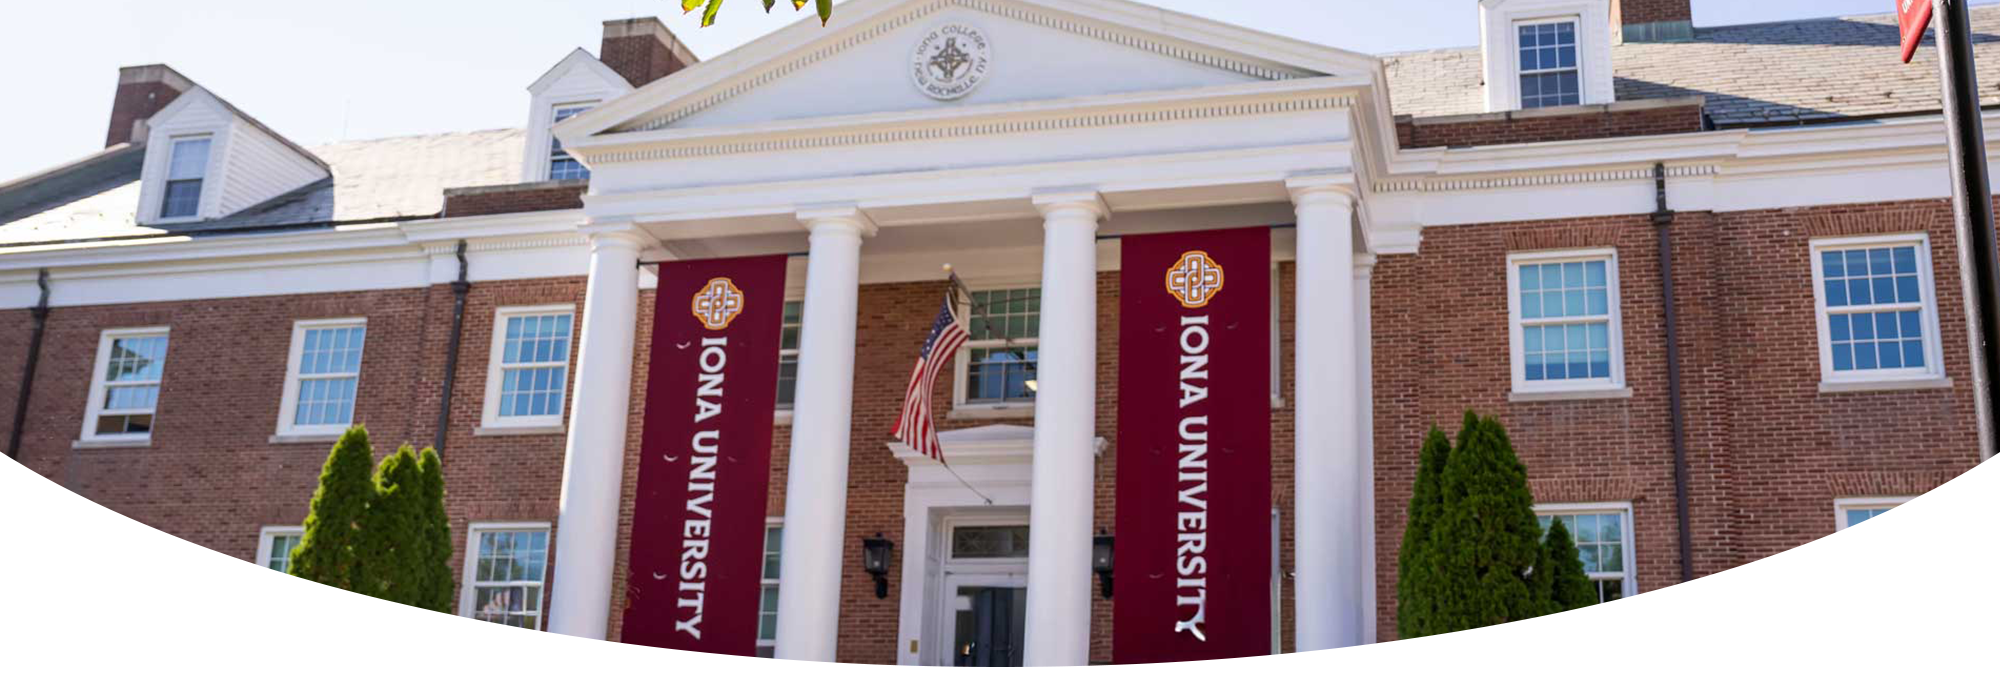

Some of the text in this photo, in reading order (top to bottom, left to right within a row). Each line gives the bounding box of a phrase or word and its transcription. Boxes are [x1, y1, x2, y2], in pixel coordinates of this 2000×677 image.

[675, 336, 728, 640] IONA UNIVERSITY
[1175, 315, 1209, 641] IONA UNIVERSITY
